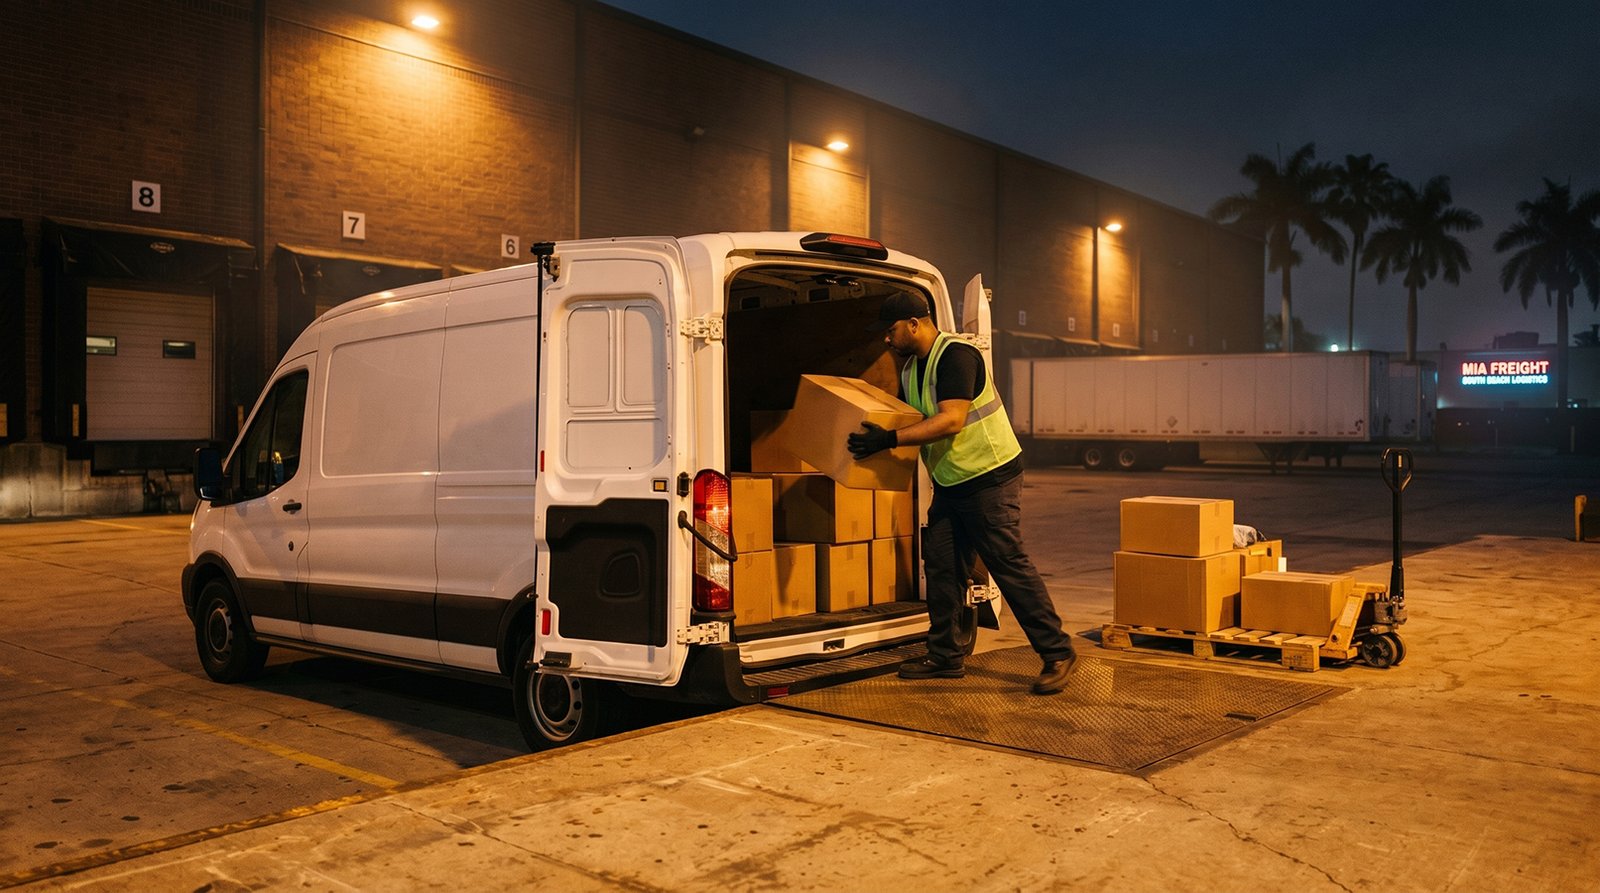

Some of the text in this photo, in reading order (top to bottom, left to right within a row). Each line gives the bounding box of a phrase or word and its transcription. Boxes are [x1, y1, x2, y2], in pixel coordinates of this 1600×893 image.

[139, 187, 154, 207] 8
[348, 216, 360, 234] 7
[506, 238, 516, 255] 6
[1462, 360, 1549, 375] MIA FREIGHT
[1462, 375, 1548, 385] SOUTH BEACH LOGISTICS
